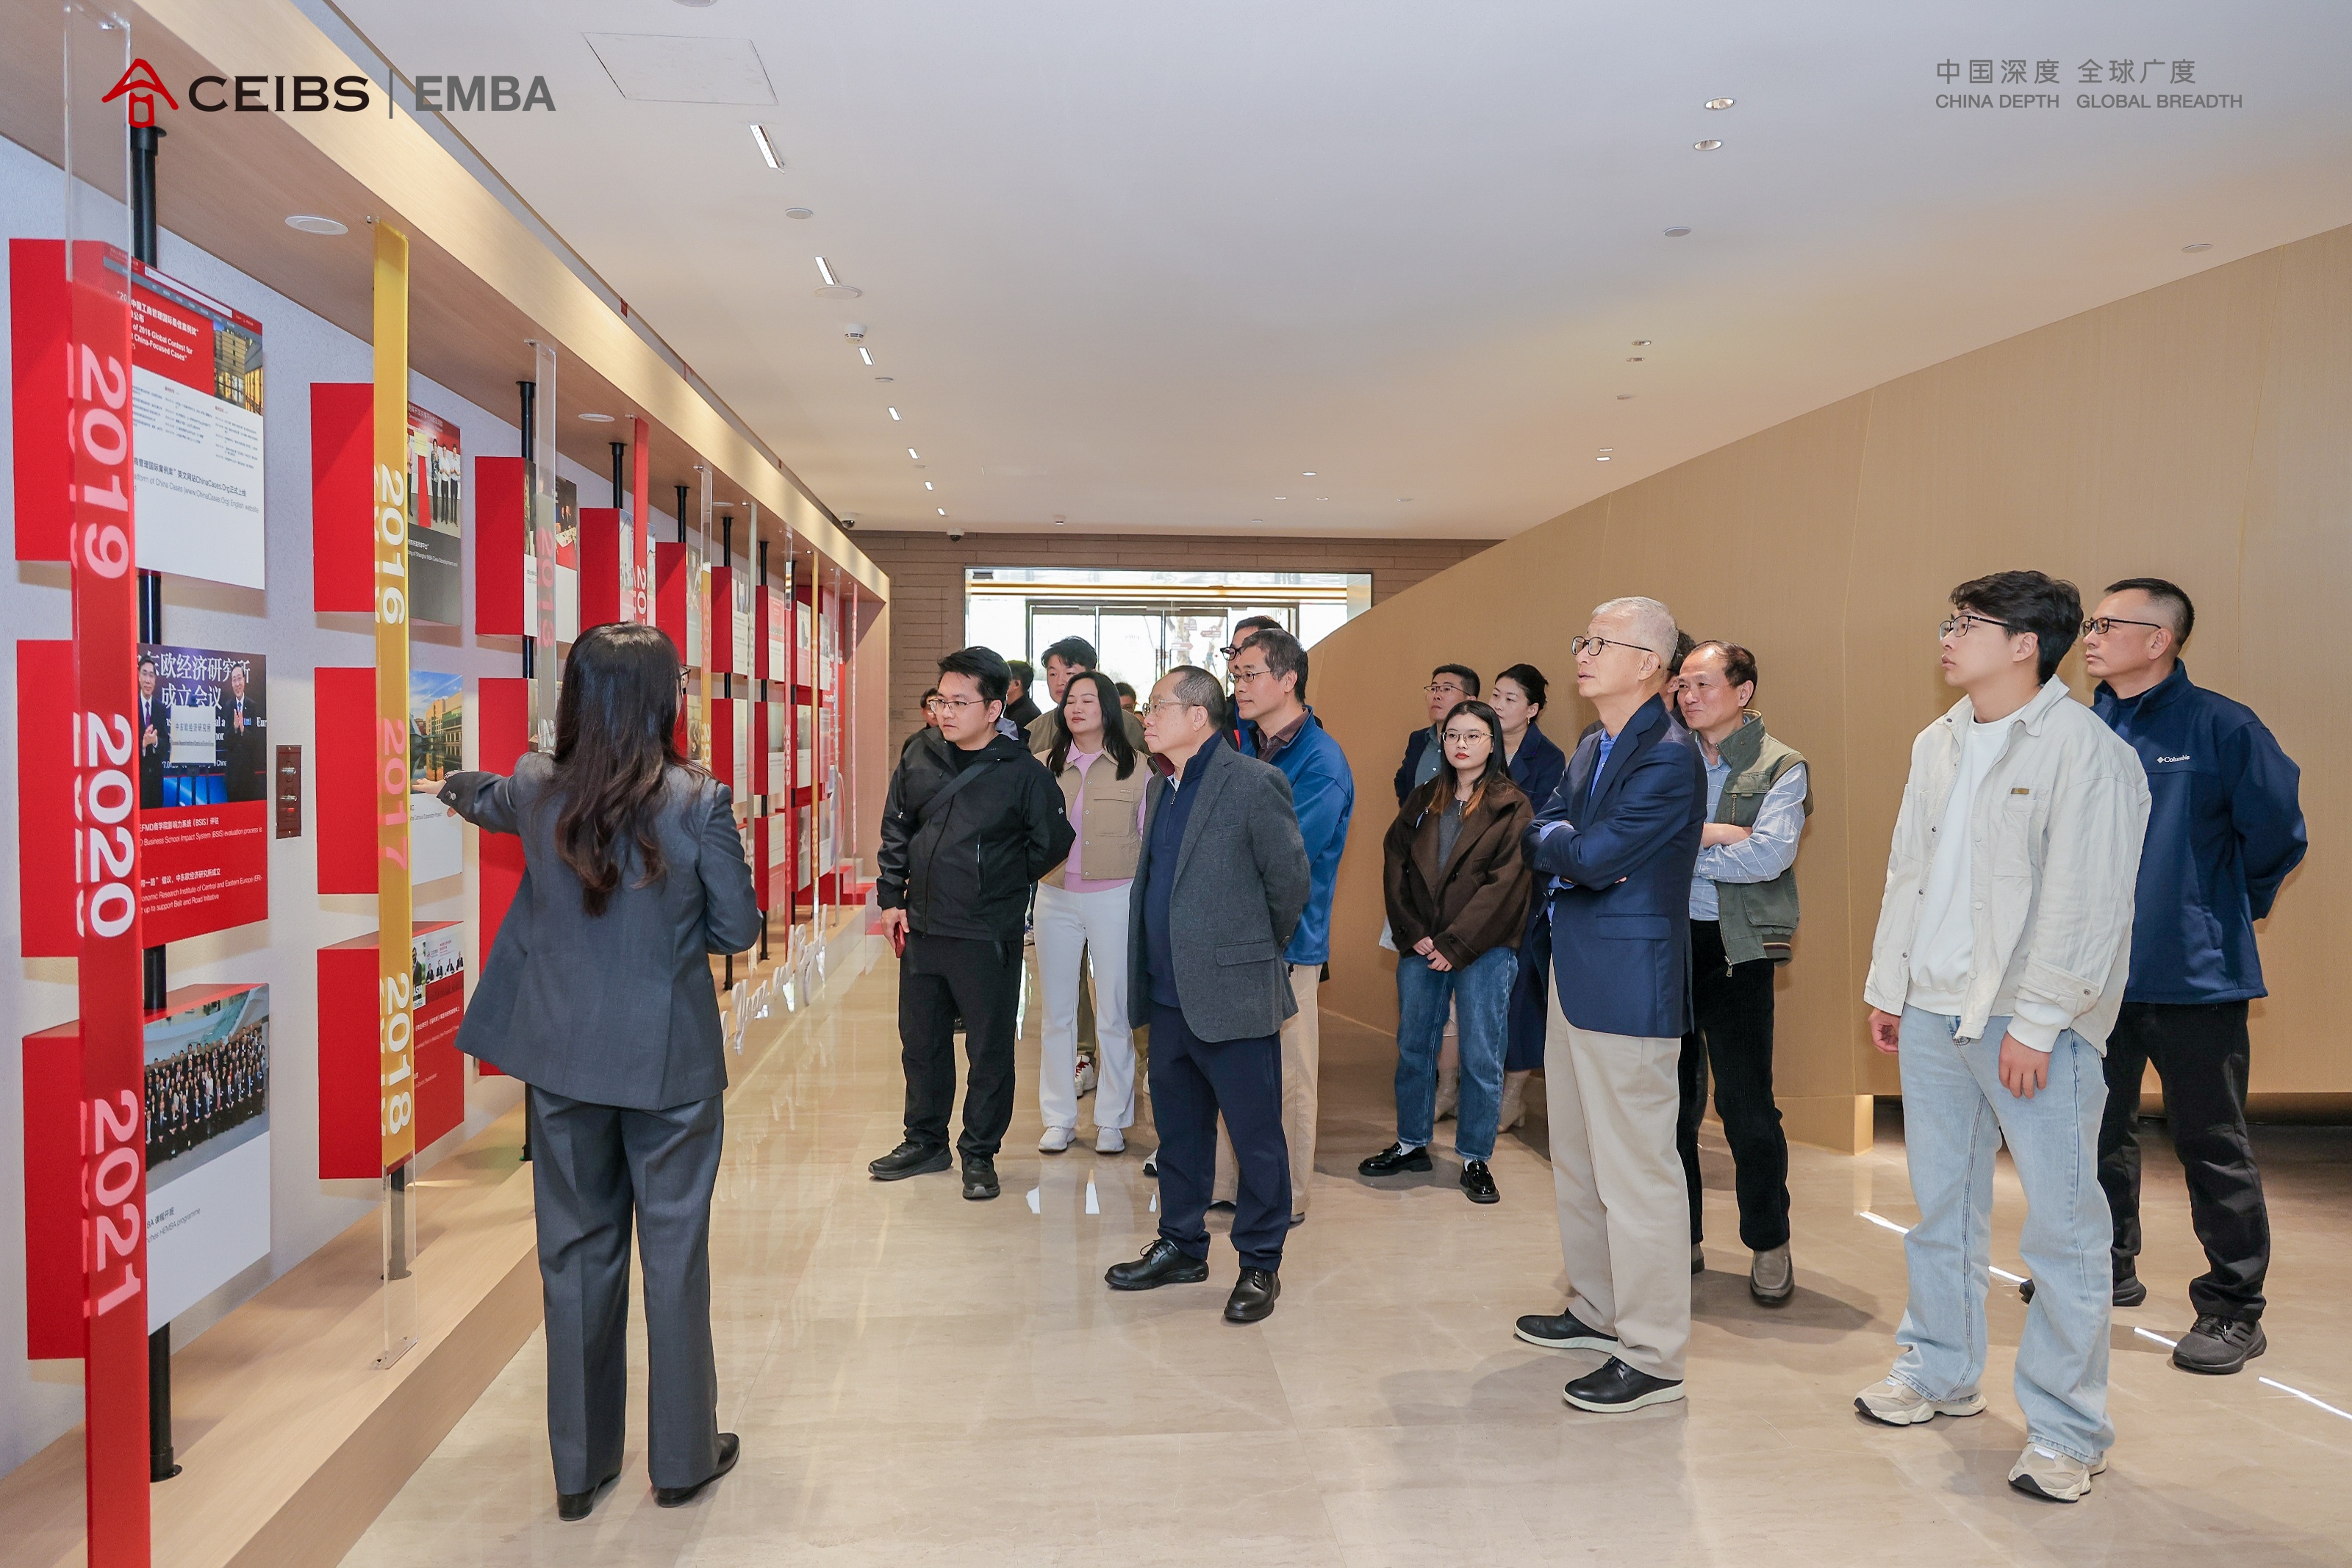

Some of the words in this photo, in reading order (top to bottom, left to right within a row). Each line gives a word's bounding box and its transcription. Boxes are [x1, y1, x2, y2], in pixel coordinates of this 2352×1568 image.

[134, 333, 171, 356] China-Focused
[138, 326, 151, 336] 2016
[151, 330, 168, 342] Global
[168, 337, 185, 351] Contest
[81, 343, 129, 579] 2019
[149, 477, 154, 485] of
[155, 478, 169, 490] China
[169, 482, 183, 493] Cases
[230, 498, 244, 509] English
[244, 503, 259, 514] website
[381, 464, 405, 625] 2016
[541, 527, 555, 648] 2013
[637, 565, 647, 625] 20
[137, 650, 251, 684] 东欧经济研究所
[162, 683, 223, 711] 成立会议
[2164, 754, 2190, 763] Columbia
[384, 718, 409, 871] 2017
[87, 711, 136, 938] 2020
[143, 838, 165, 846] Business
[165, 835, 181, 844] School
[180, 834, 196, 842] Impact
[196, 832, 211, 841] System
[243, 827, 259, 835] process
[156, 902, 173, 912] support
[173, 899, 182, 908] Belt
[203, 893, 220, 902] Initiative
[159, 888, 179, 898] Research
[179, 885, 196, 895] Institute
[201, 882, 217, 891] Central
[224, 879, 240, 888] Eastern
[240, 877, 254, 886] Europe
[387, 972, 412, 1135] 2018
[95, 1089, 141, 1317] 2021
